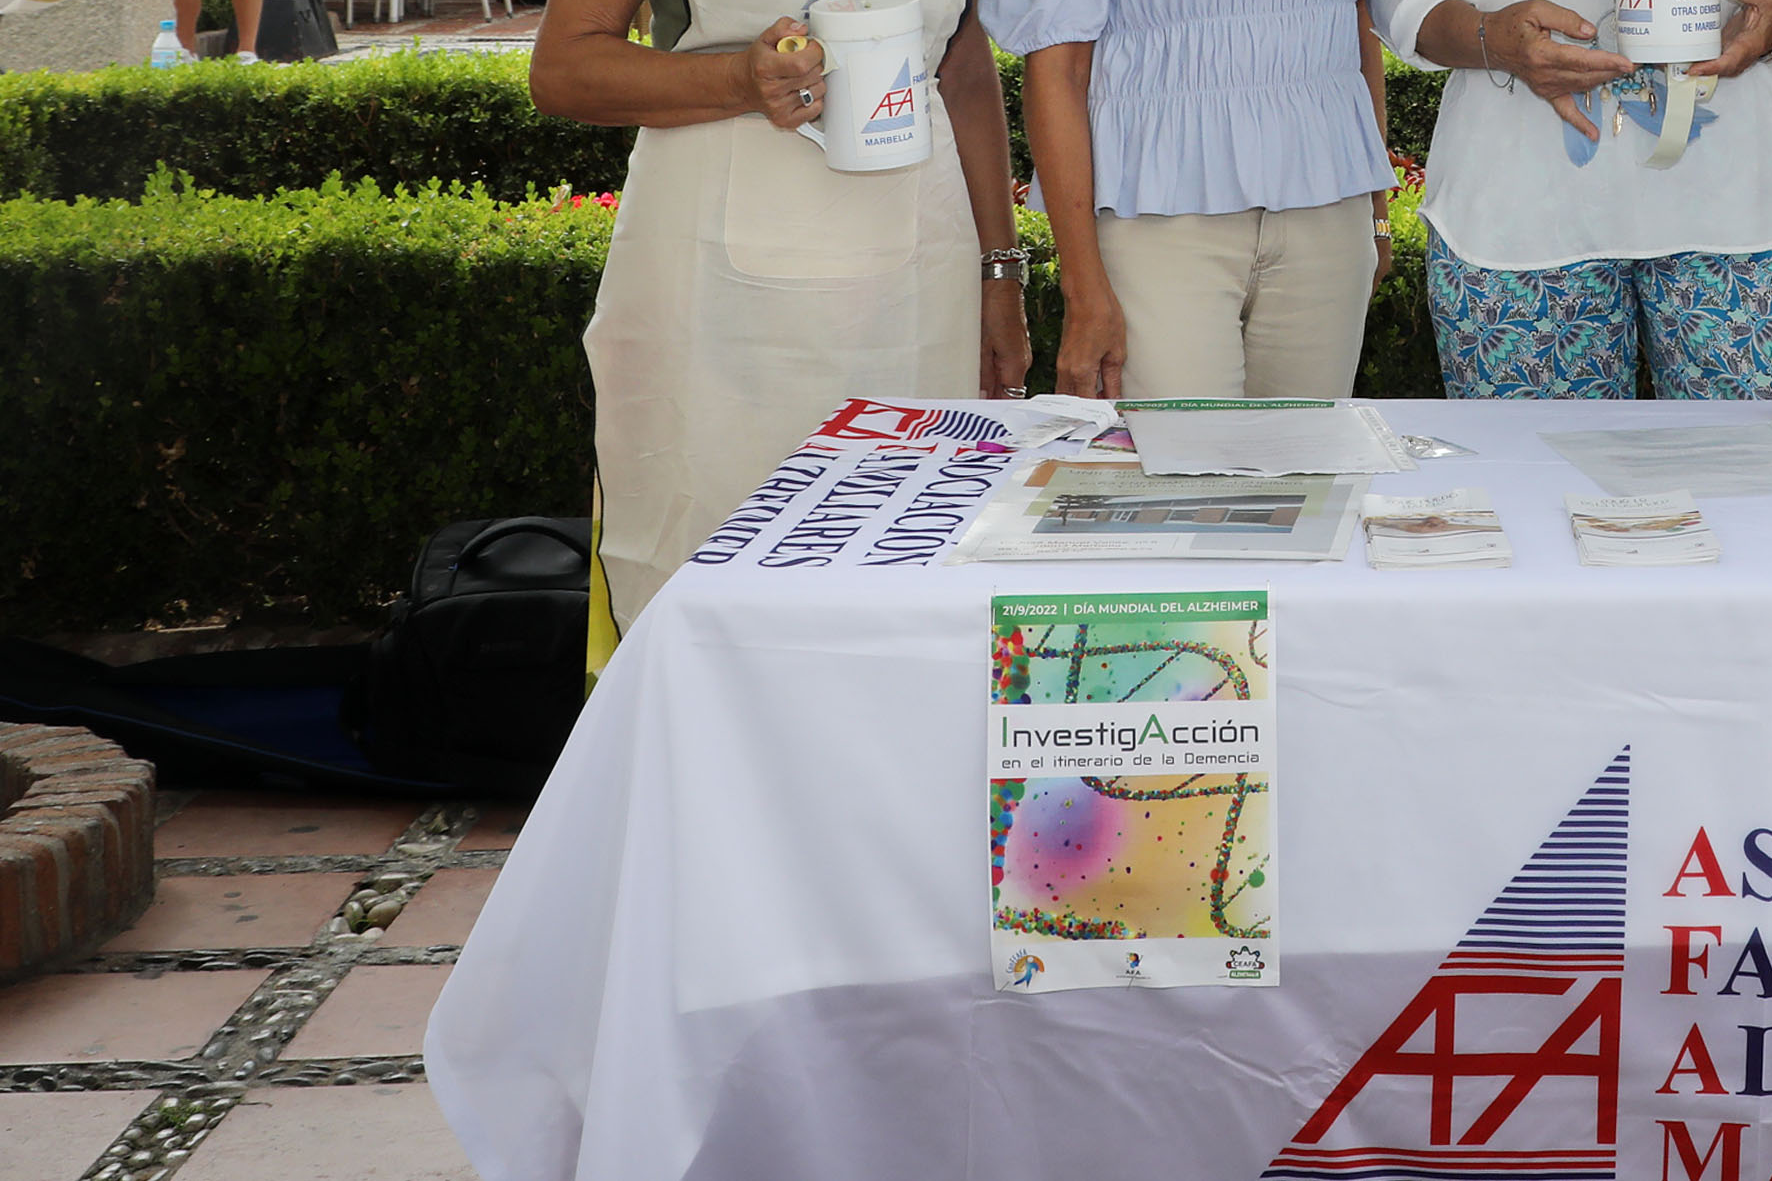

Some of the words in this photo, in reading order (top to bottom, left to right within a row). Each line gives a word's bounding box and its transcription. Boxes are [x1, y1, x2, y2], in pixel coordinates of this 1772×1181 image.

[1671, 7, 1698, 17] OTRAS
[1682, 22, 1693, 33] DE
[870, 87, 914, 120] AFA
[865, 132, 914, 147] MARBELLA
[1002, 604, 1058, 617] 21/9/2022
[1073, 601, 1096, 615] DÍA
[1098, 602, 1157, 615] MUNDIAL
[1160, 602, 1185, 613] DEL
[1187, 600, 1259, 612] ALZHEIMER
[1002, 714, 1259, 751] InvestigAcción
[1001, 758, 1021, 769] en
[1031, 756, 1044, 769] el
[1053, 754, 1123, 768] itinerario
[1133, 753, 1153, 766] de
[1162, 753, 1175, 766] la
[1184, 752, 1260, 765] Demencia
[1290, 975, 1622, 1146] AFA
